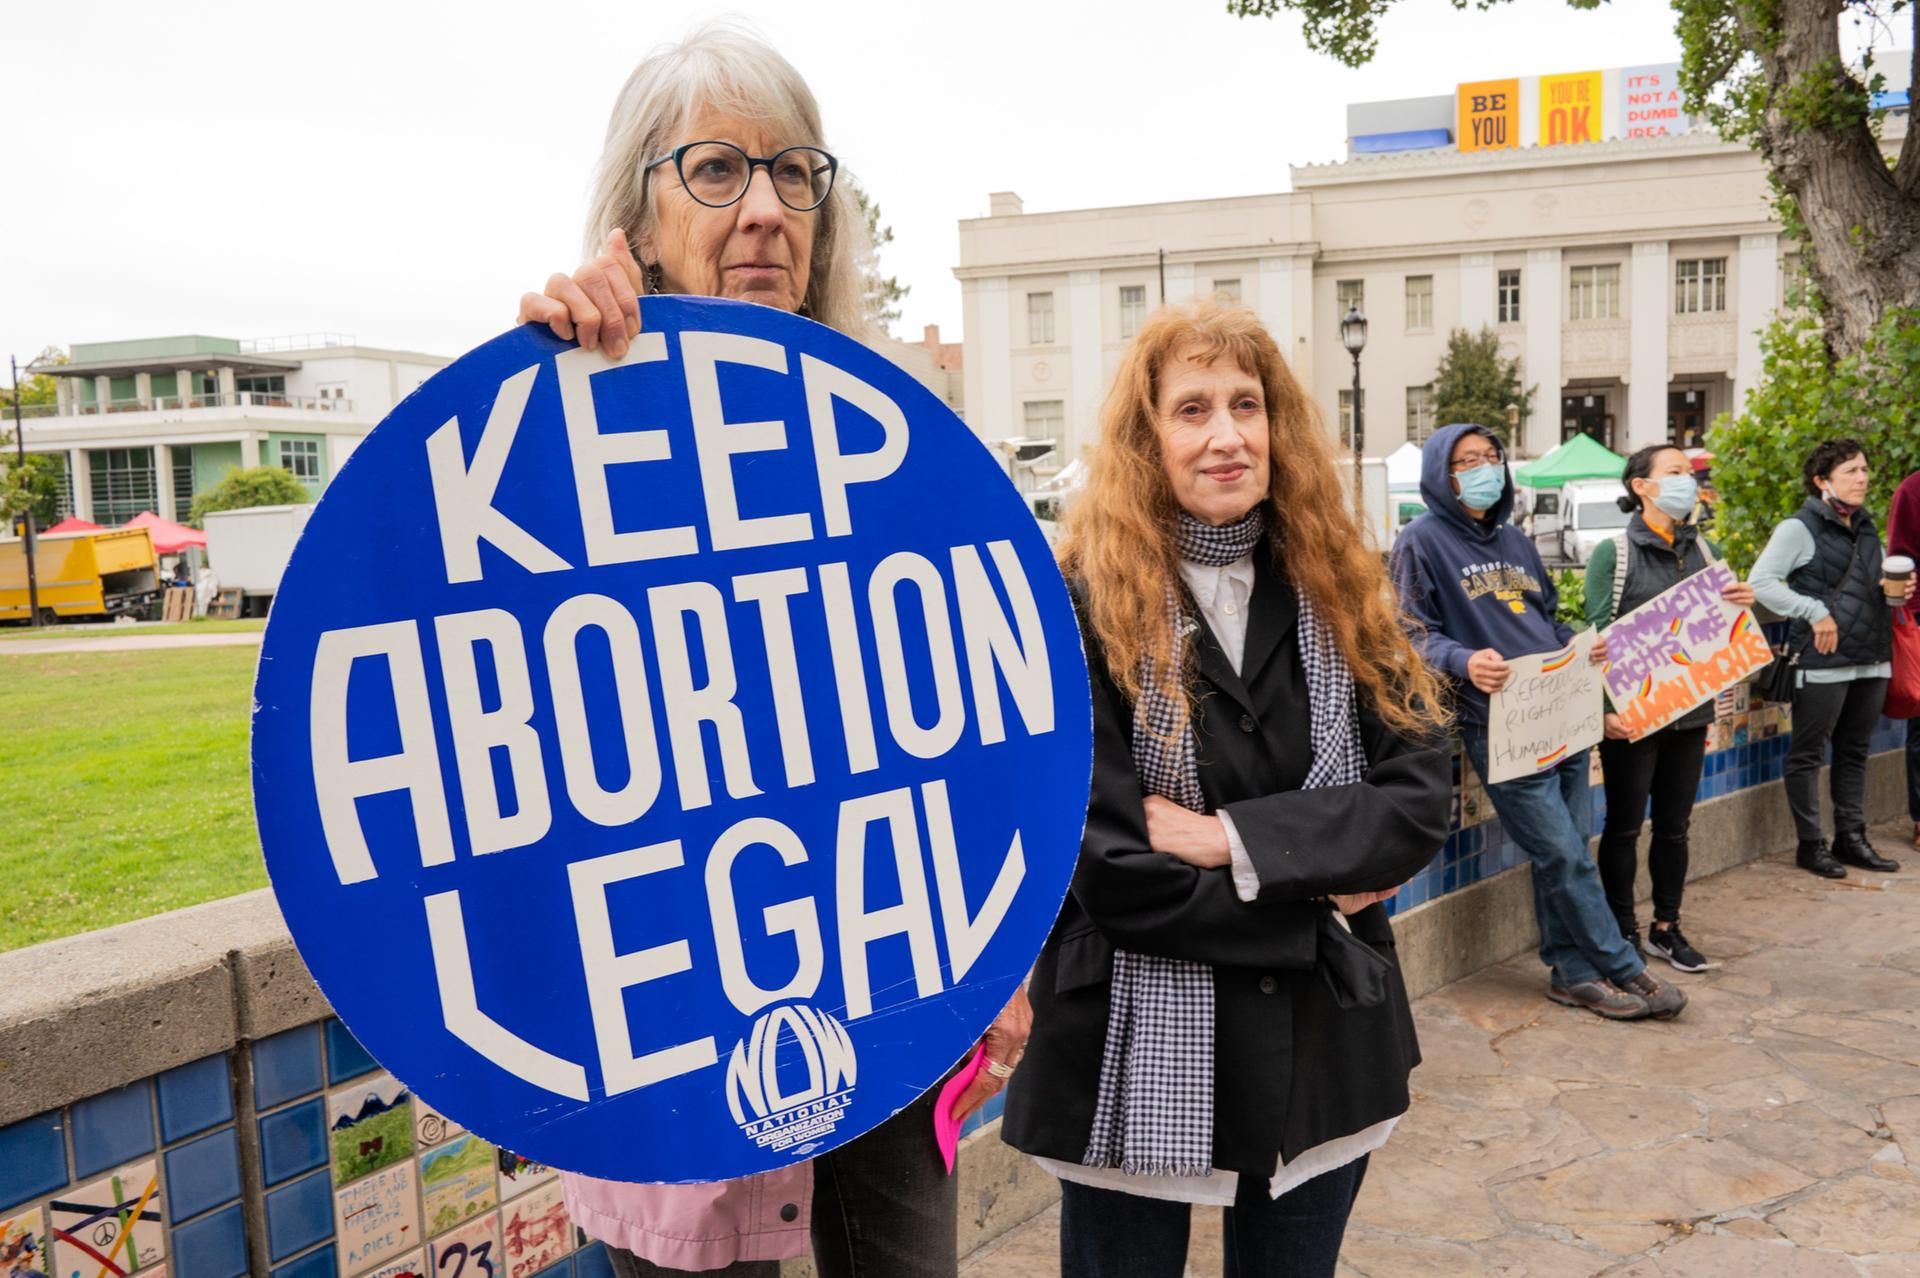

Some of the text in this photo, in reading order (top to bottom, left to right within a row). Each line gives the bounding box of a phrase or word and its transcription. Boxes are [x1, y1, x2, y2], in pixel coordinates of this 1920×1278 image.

[1550, 79, 1591, 104] YOU'RE
[1628, 74, 1660, 88] IT'S
[1471, 94, 1506, 112] BE
[1628, 90, 1679, 105] NOT A
[1548, 106, 1592, 147] OK
[1628, 107, 1678, 121] DUMB
[1472, 116, 1506, 146] YOU
[1628, 126, 1666, 139] IDEA
[426, 331, 910, 585] KEEP
[1605, 631, 1681, 698] RIGHTS
[310, 539, 1056, 886] ABORTION
[1494, 738, 1554, 767] HUMAN
[424, 779, 1027, 1102] LEGAL
[725, 1004, 858, 1126] NOW
[745, 1094, 852, 1136] NATIONAL
[756, 1109, 845, 1145] ORGANIZATION
[771, 1137, 793, 1150] FOR
[794, 1122, 836, 1143] WOMEN
[339, 1173, 386, 1203] THERE
